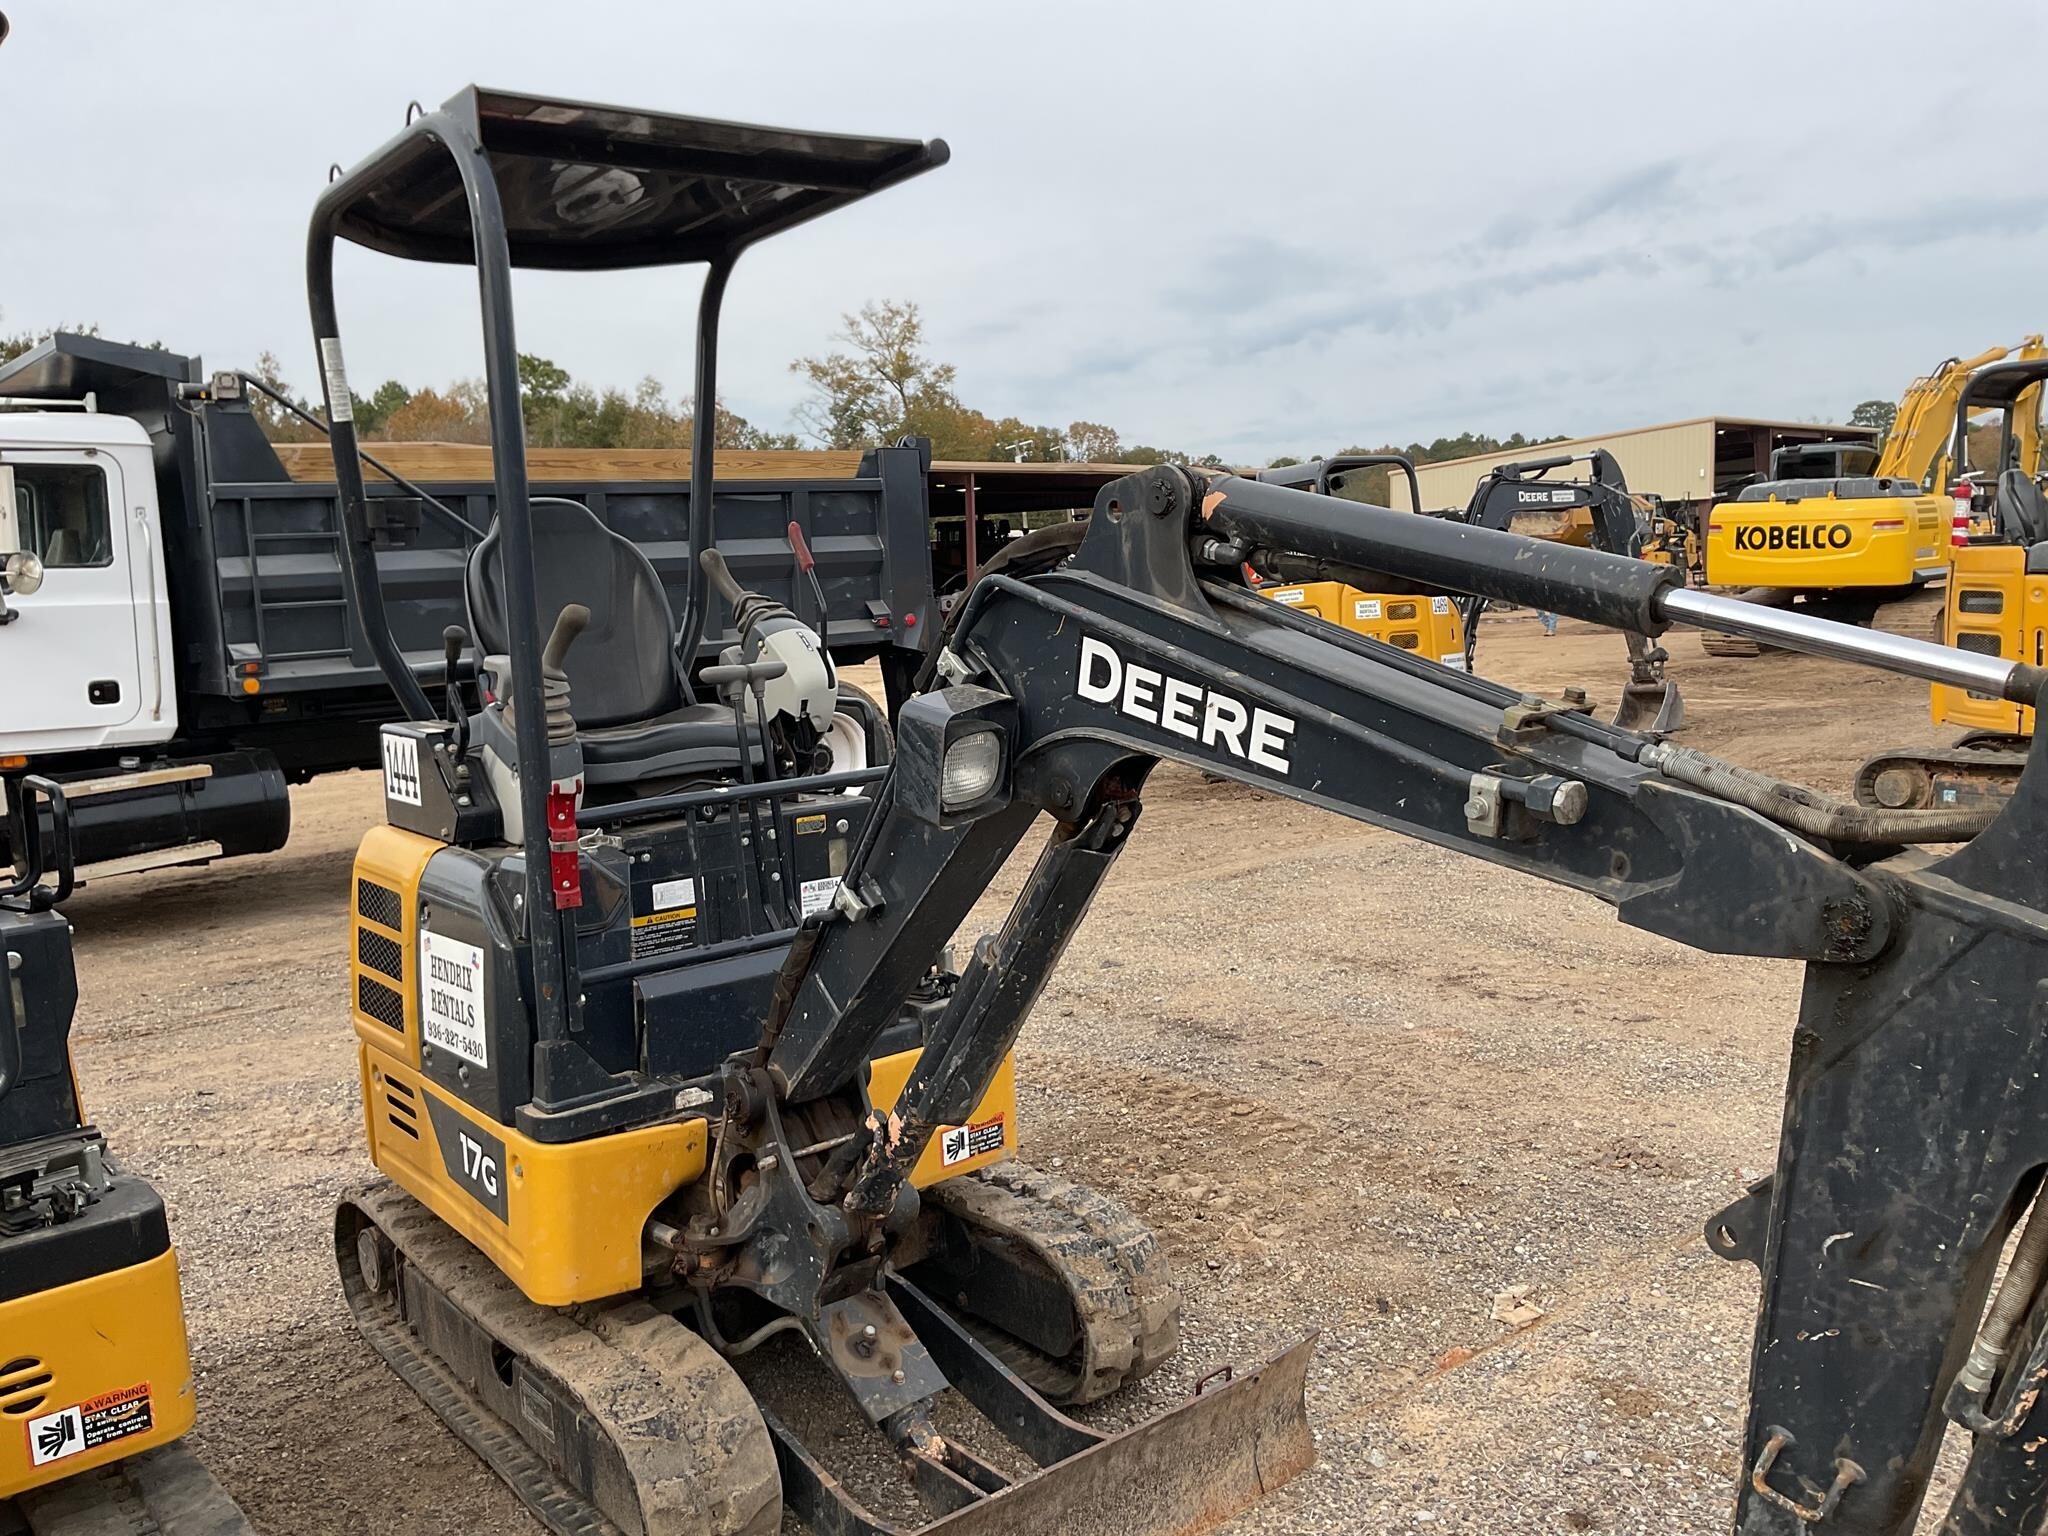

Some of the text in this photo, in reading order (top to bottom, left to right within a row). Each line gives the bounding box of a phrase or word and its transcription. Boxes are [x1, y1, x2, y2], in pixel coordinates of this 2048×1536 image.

[1518, 491, 1549, 502] DEERE
[1735, 524, 1852, 550] KOBELCO
[1077, 636, 1295, 774] DEERE
[386, 739, 419, 799] 1444
[655, 912, 681, 922] CAUTION
[430, 954, 473, 992] HENDRIX
[431, 989, 475, 1028] RENTALS
[427, 1020, 483, 1060] 936-327-5430
[459, 1131, 498, 1197] 17G
[94, 1385, 148, 1408] WARNING
[85, 1400, 139, 1423] STAY CLEAR
[87, 1426, 115, 1438] Operate
[118, 1415, 148, 1428] controls
[88, 1436, 103, 1445] only
[106, 1430, 123, 1439] from
